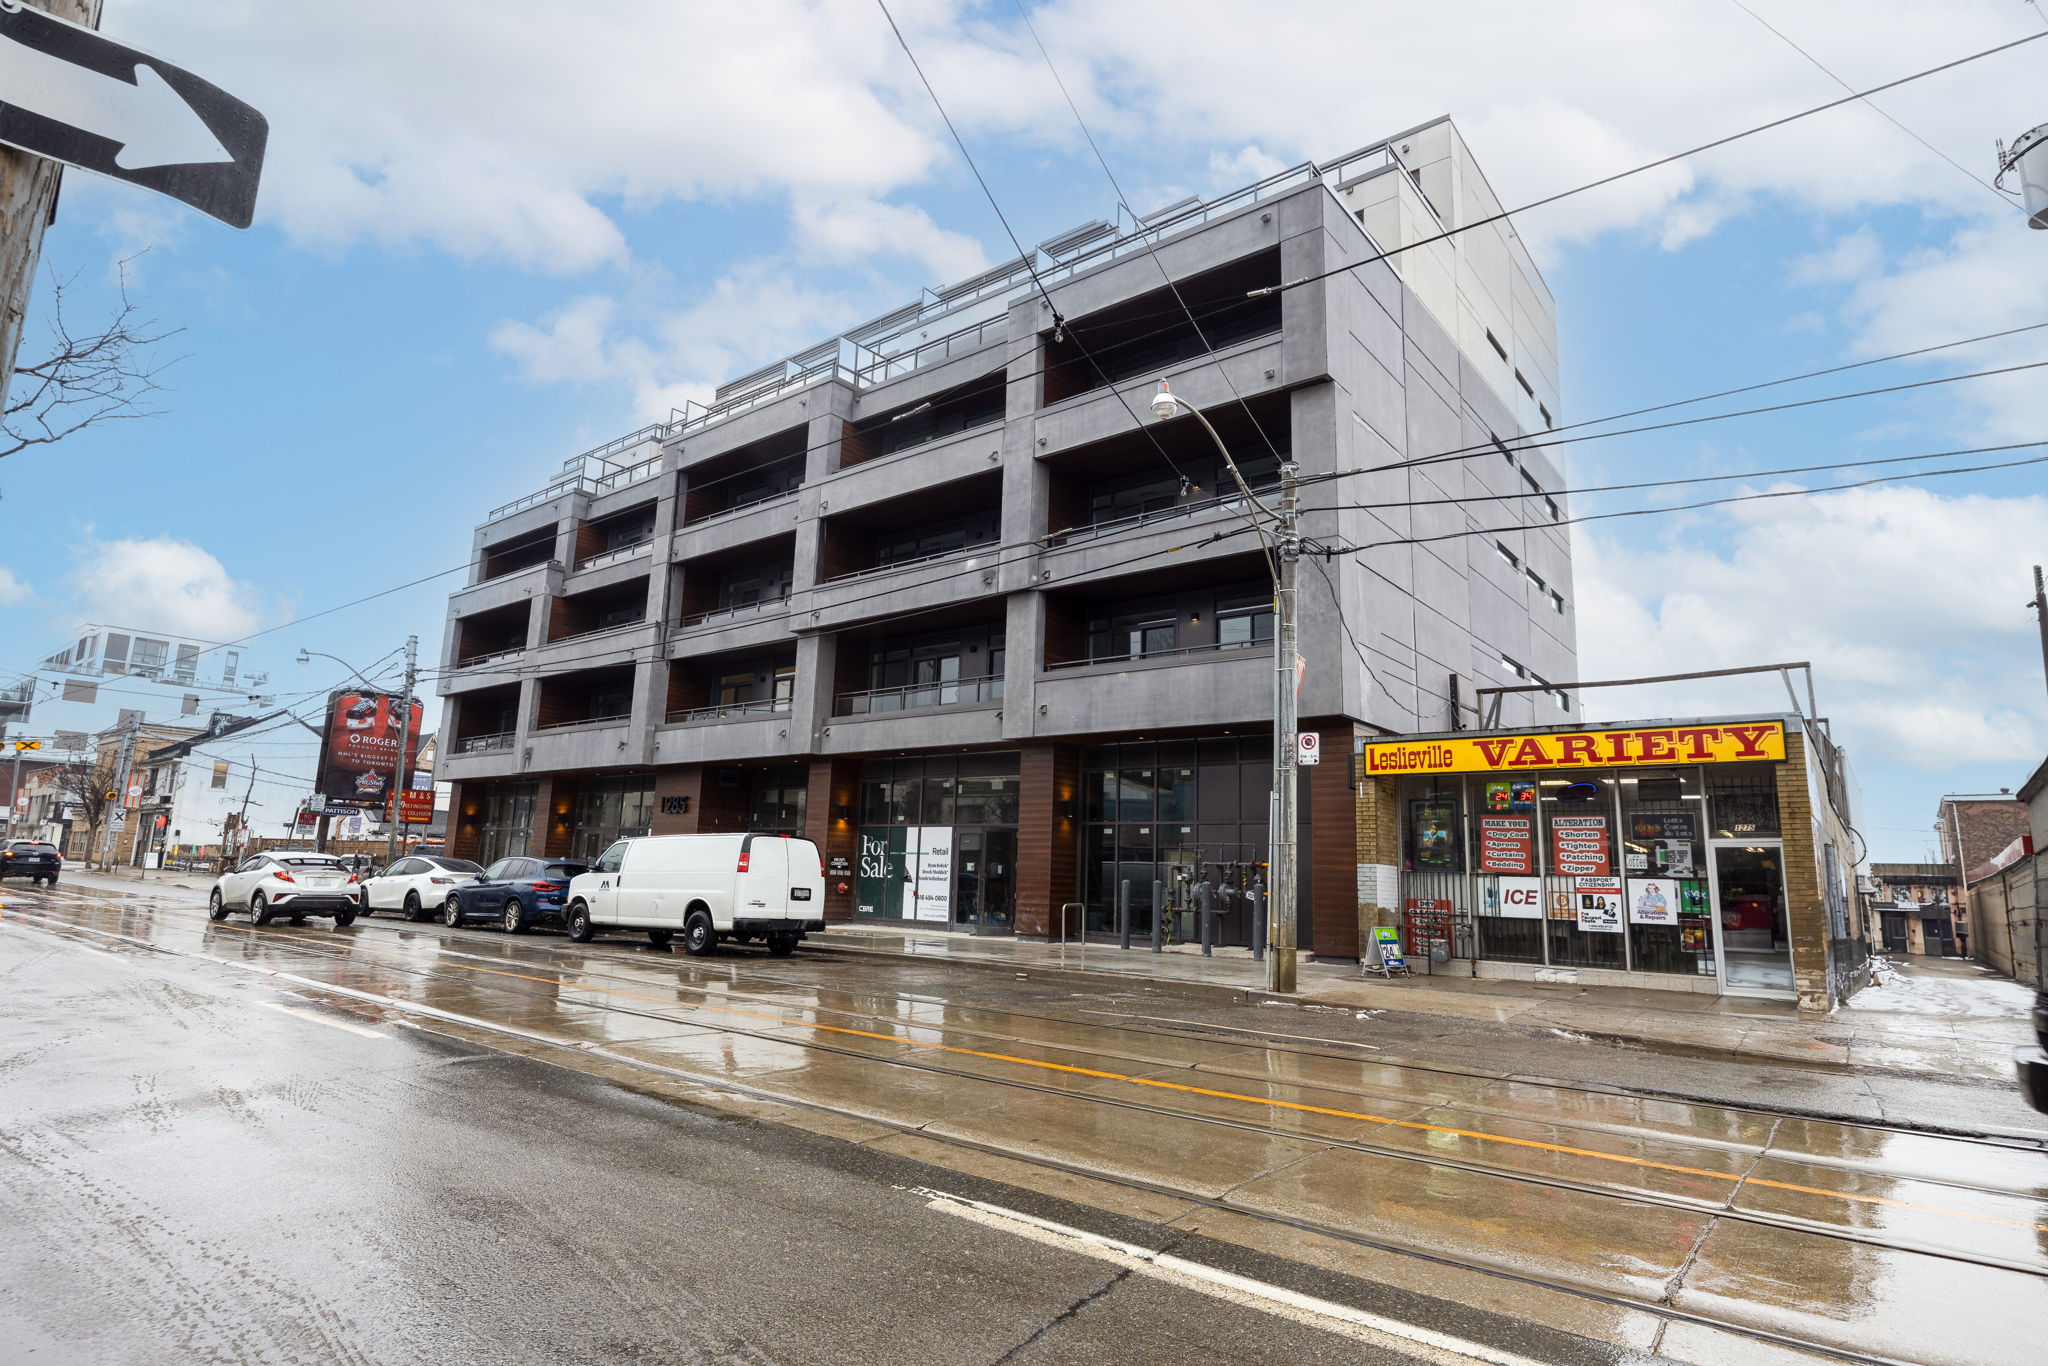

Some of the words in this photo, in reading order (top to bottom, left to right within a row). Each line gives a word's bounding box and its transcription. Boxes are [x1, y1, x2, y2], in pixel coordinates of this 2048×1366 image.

[362, 736, 399, 747] ROGER
[1472, 725, 1778, 769] VARIETY
[1369, 745, 1453, 771] Leslieville
[363, 760, 394, 768] TORONTO
[409, 791, 417, 799] M
[419, 792, 424, 800] &
[426, 792, 431, 800] S
[1495, 792, 1508, 801] 24
[1520, 792, 1533, 801] 34
[1484, 820, 1507, 828] MAKE
[1508, 820, 1528, 828] YOUR
[1553, 818, 1604, 827] ALTERATION
[1492, 831, 1508, 839] Dog
[861, 834, 888, 856] For
[1491, 841, 1519, 849] Aprons
[1565, 842, 1598, 850] Tighten
[932, 847, 949, 856] Retail
[1565, 853, 1604, 862] Patching
[860, 855, 894, 878] Sale
[1491, 861, 1524, 869] Bedding
[1567, 864, 1595, 873] Zipper
[1503, 889, 1538, 905] ICE
[858, 905, 874, 913] CBRE
[1637, 909, 1669, 917] Alterations
[1383, 946, 1395, 959] 24
